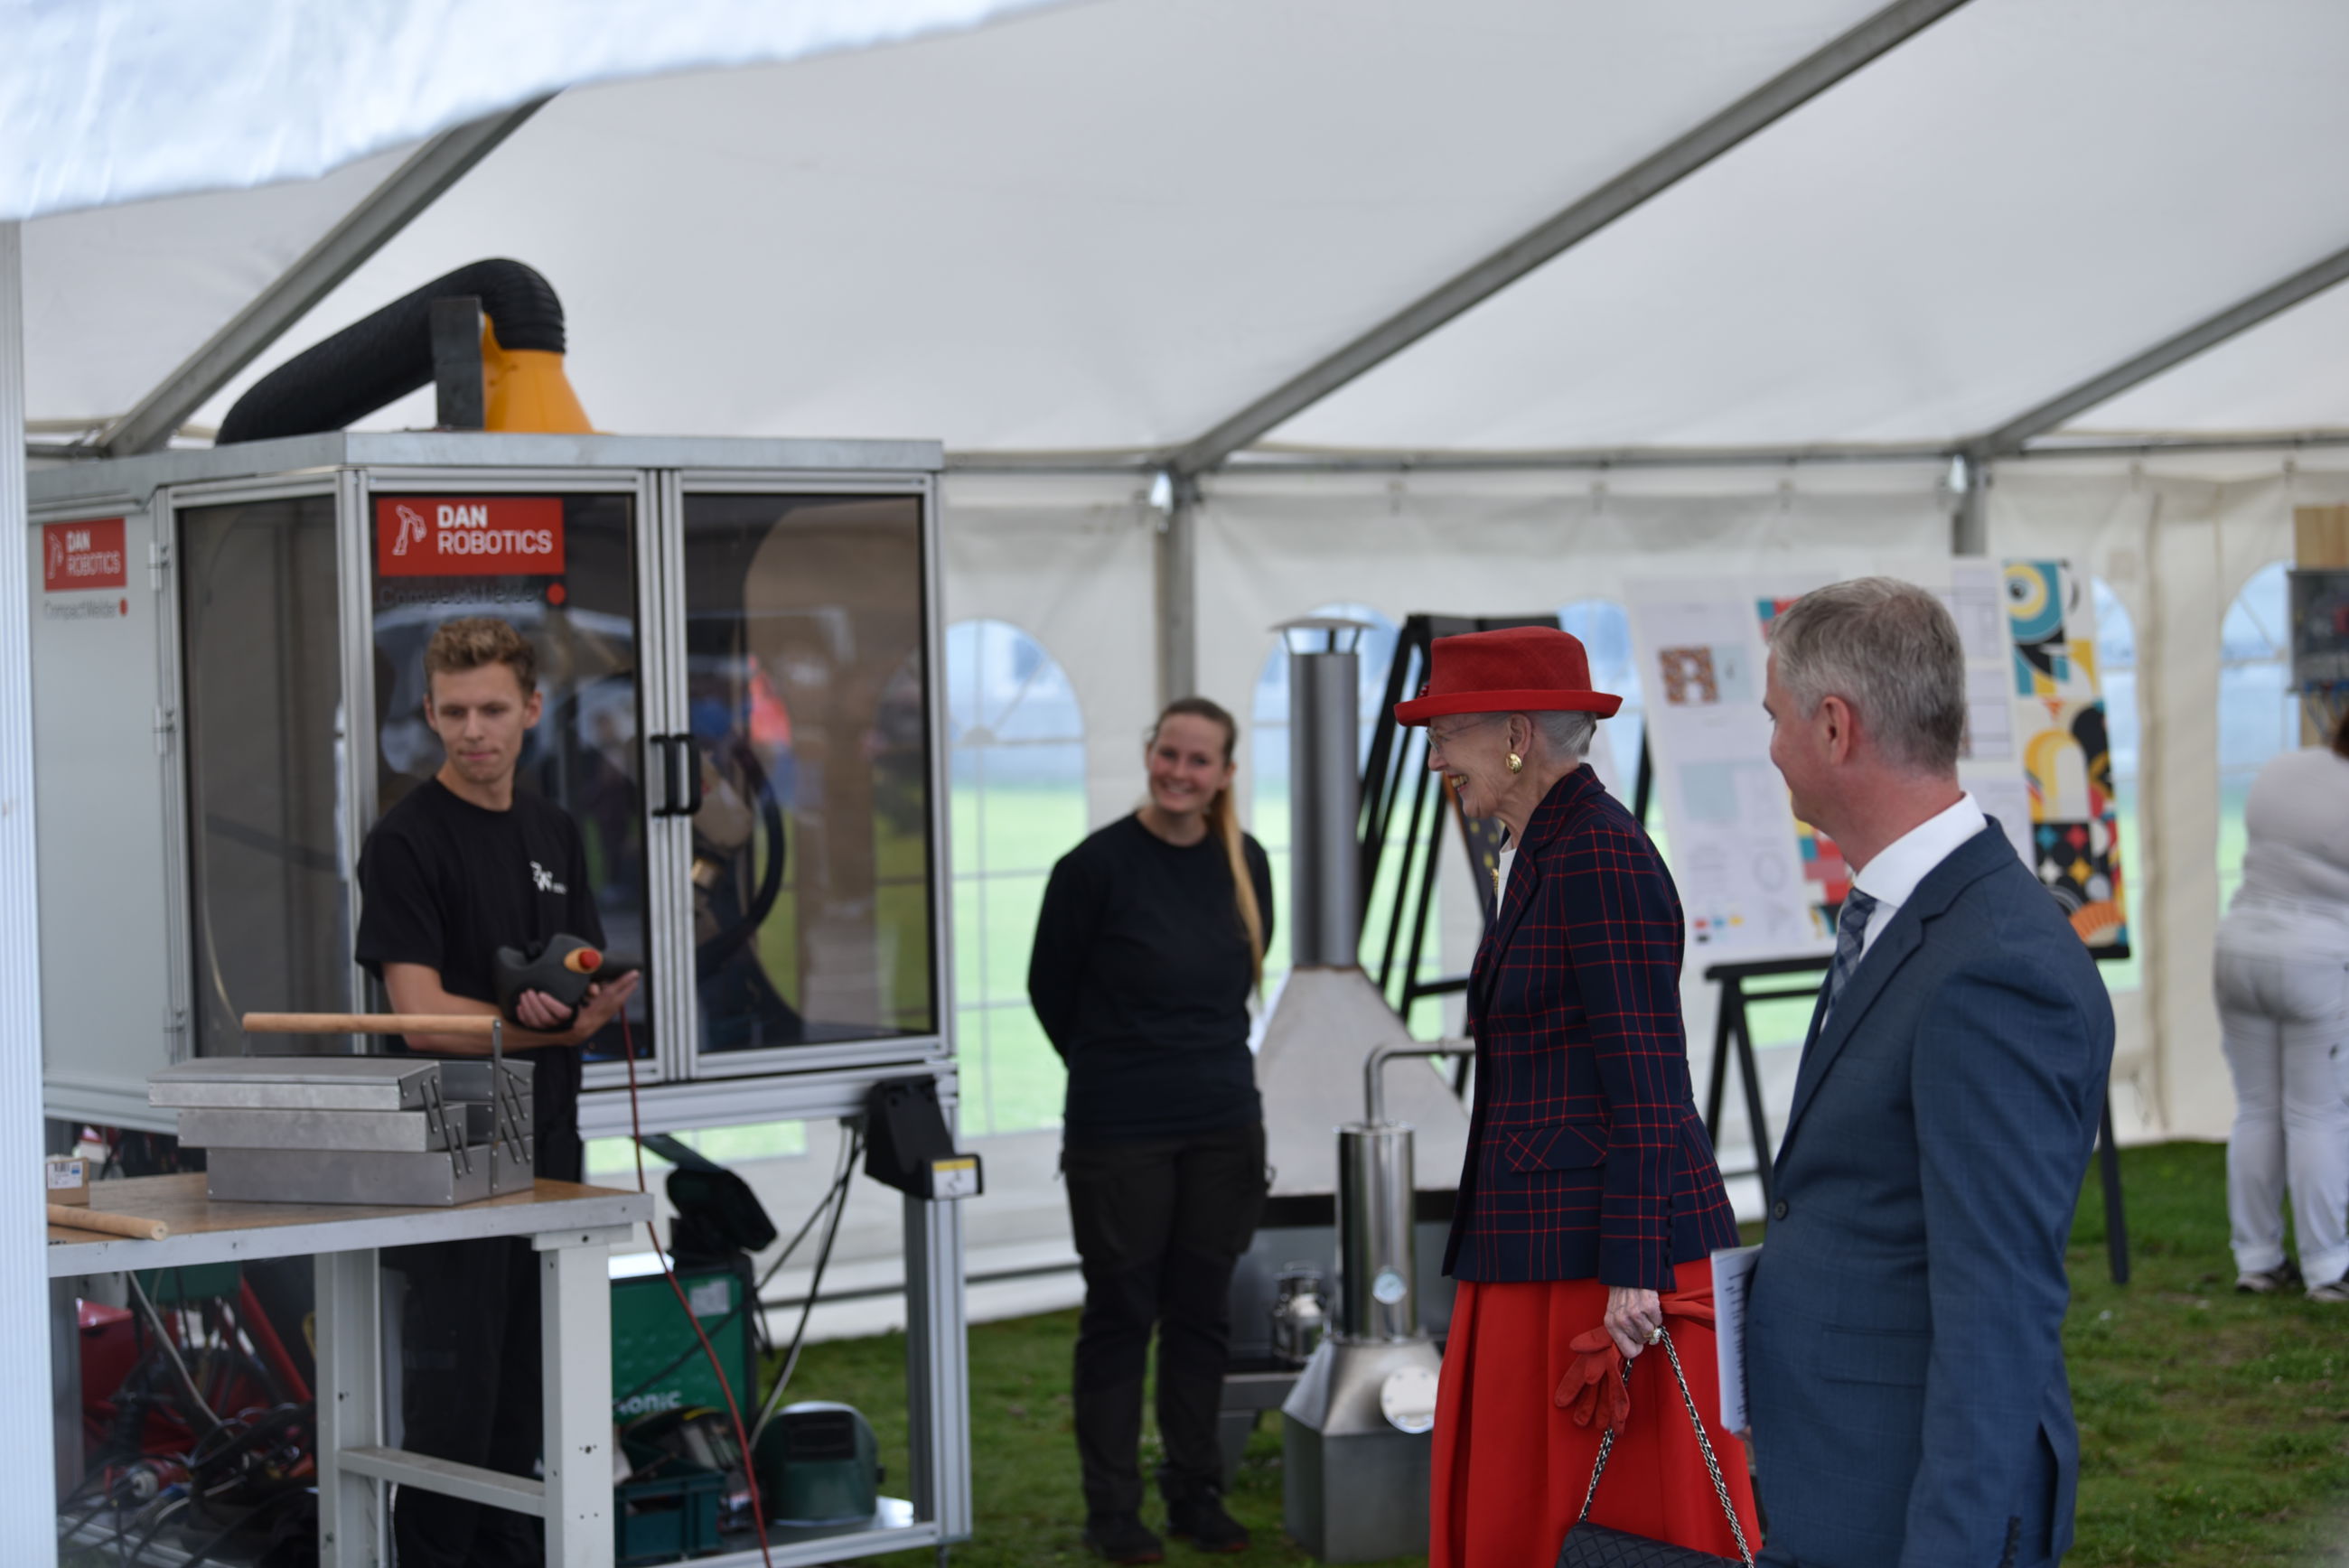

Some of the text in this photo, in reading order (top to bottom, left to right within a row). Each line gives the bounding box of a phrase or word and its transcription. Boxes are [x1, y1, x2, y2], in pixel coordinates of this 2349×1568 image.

[437, 505, 488, 528] DAN
[66, 530, 90, 553] DAN
[437, 529, 553, 555] ROBOTICS
[67, 550, 120, 576] ROBOTICS
